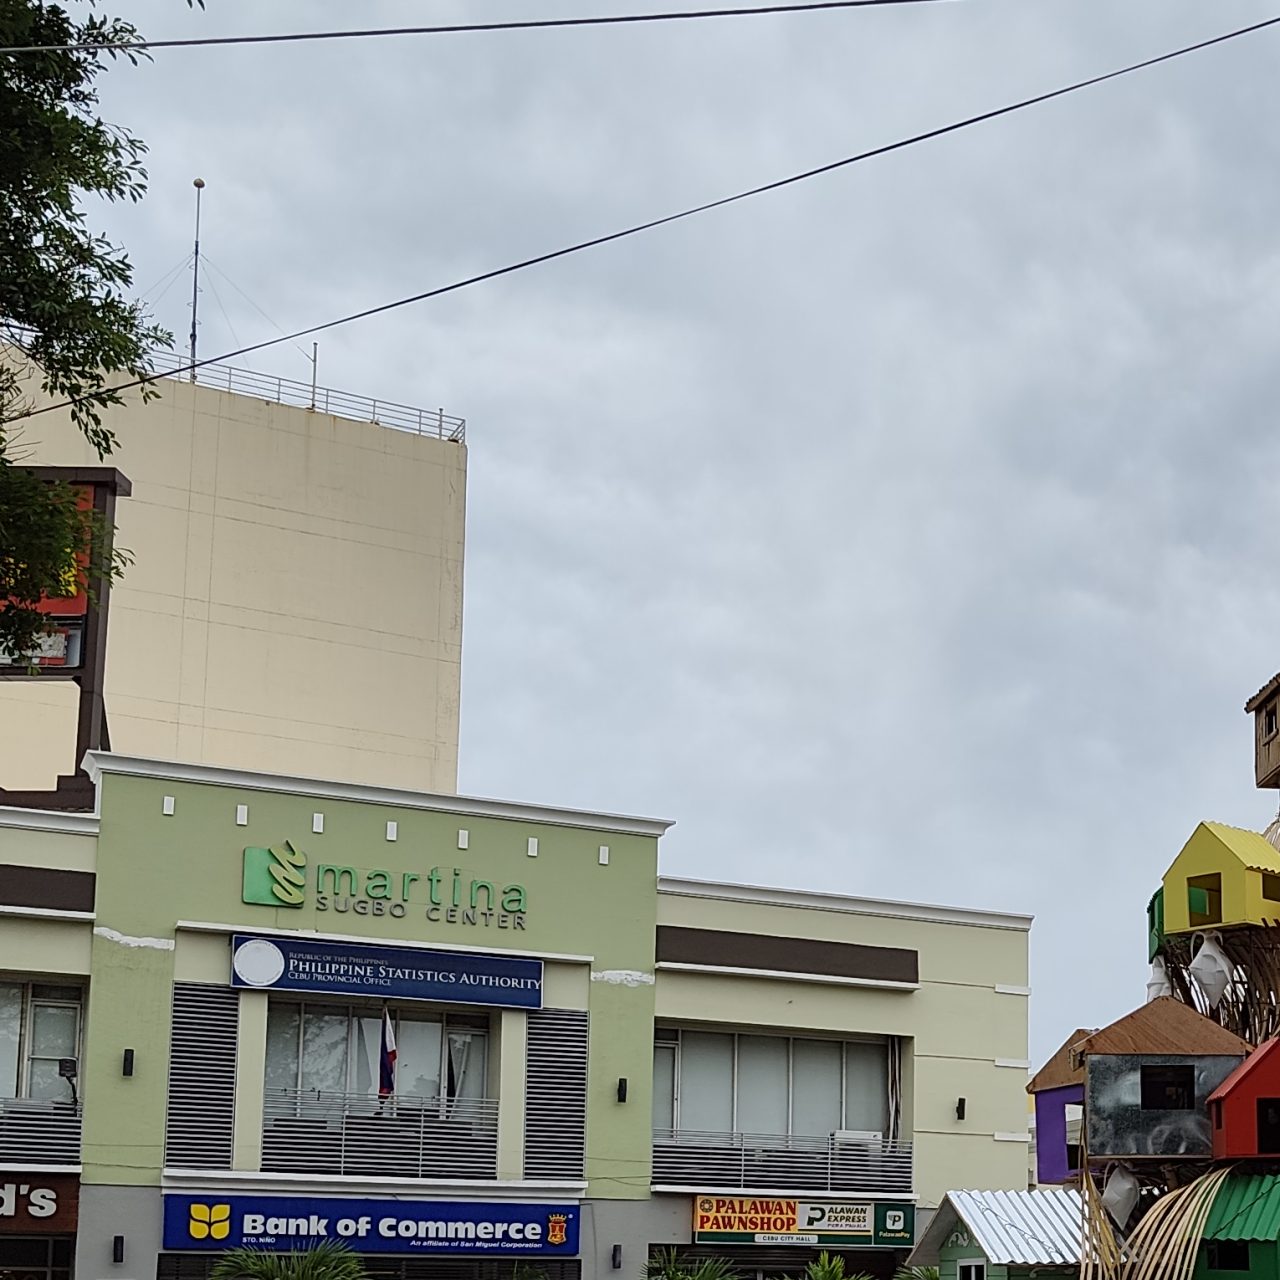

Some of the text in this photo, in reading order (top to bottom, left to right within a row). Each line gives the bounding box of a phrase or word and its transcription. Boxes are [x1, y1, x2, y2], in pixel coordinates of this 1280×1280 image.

[316, 863, 528, 913] martina
[315, 895, 526, 931] SUGBO CENTER
[289, 959, 541, 990] PHILIPPINE STATISTICS AUTHORITY
[715, 1199, 797, 1216] PALAWAN
[827, 1214, 867, 1223] EXPRESS
[242, 1213, 542, 1240] Bank of Commerce
[698, 1215, 797, 1232] PAWNSHOP
[475, 1241, 500, 1249] Miguel
[500, 1241, 543, 1249] Corporation
